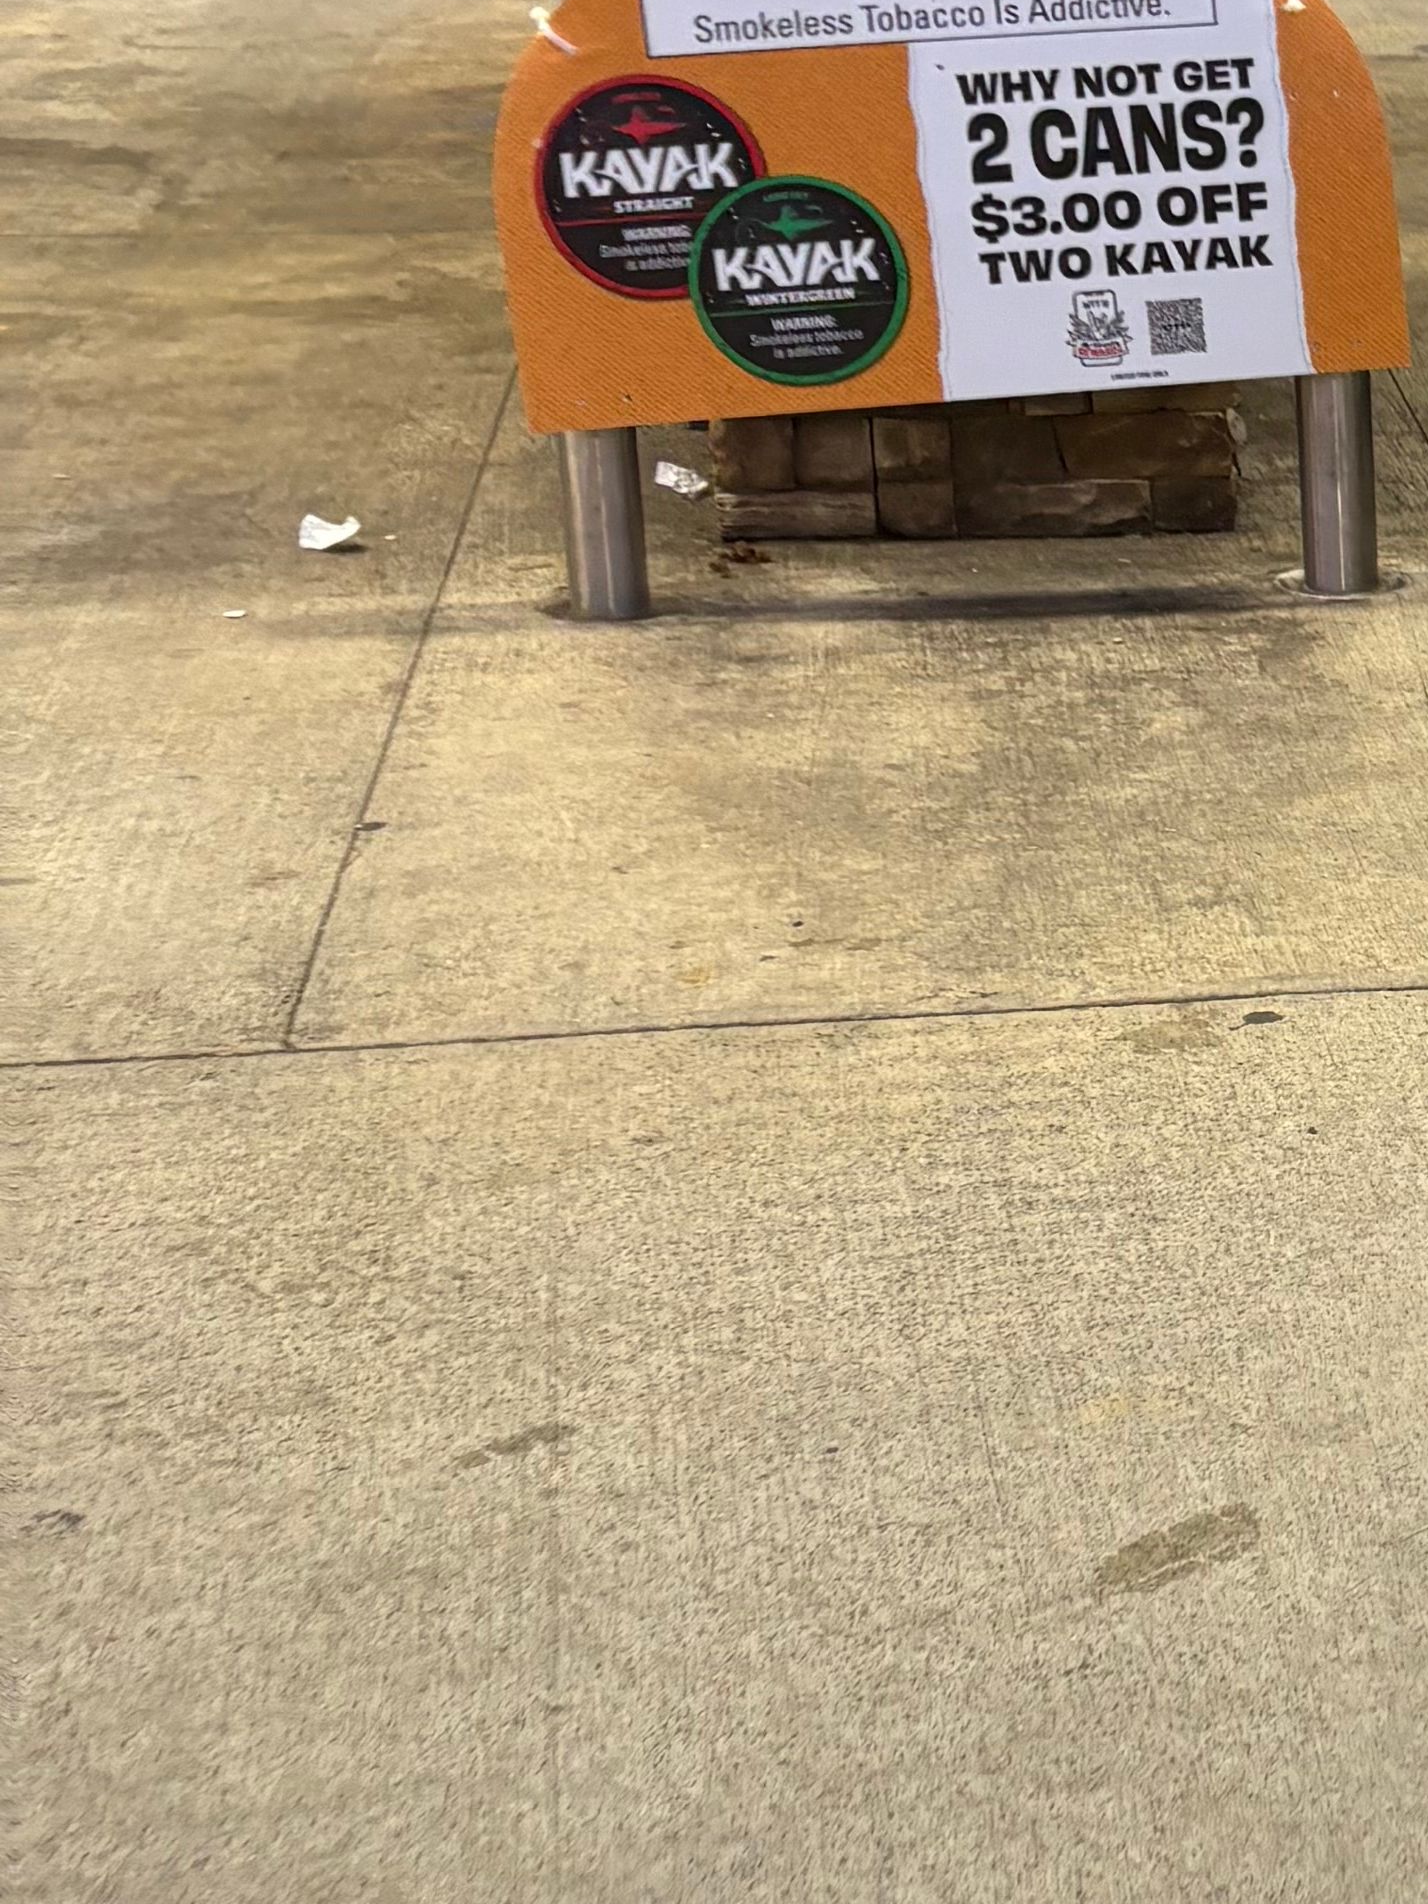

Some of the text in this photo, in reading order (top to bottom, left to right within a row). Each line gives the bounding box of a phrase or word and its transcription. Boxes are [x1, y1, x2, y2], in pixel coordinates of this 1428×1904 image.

[693, 13, 854, 44] Smokeless
[860, 1, 985, 34] Tobacco
[955, 57, 1255, 105] WHY NOT GET
[967, 97, 1265, 184] 2 CANS?
[559, 142, 739, 198] KAYAK
[613, 196, 695, 214] STRAIGHT
[970, 182, 1268, 244] $3.00 OFF
[712, 238, 880, 291] KAYAK
[978, 234, 1274, 284] TWO KAYAK
[745, 287, 856, 306] WINTERGREEN
